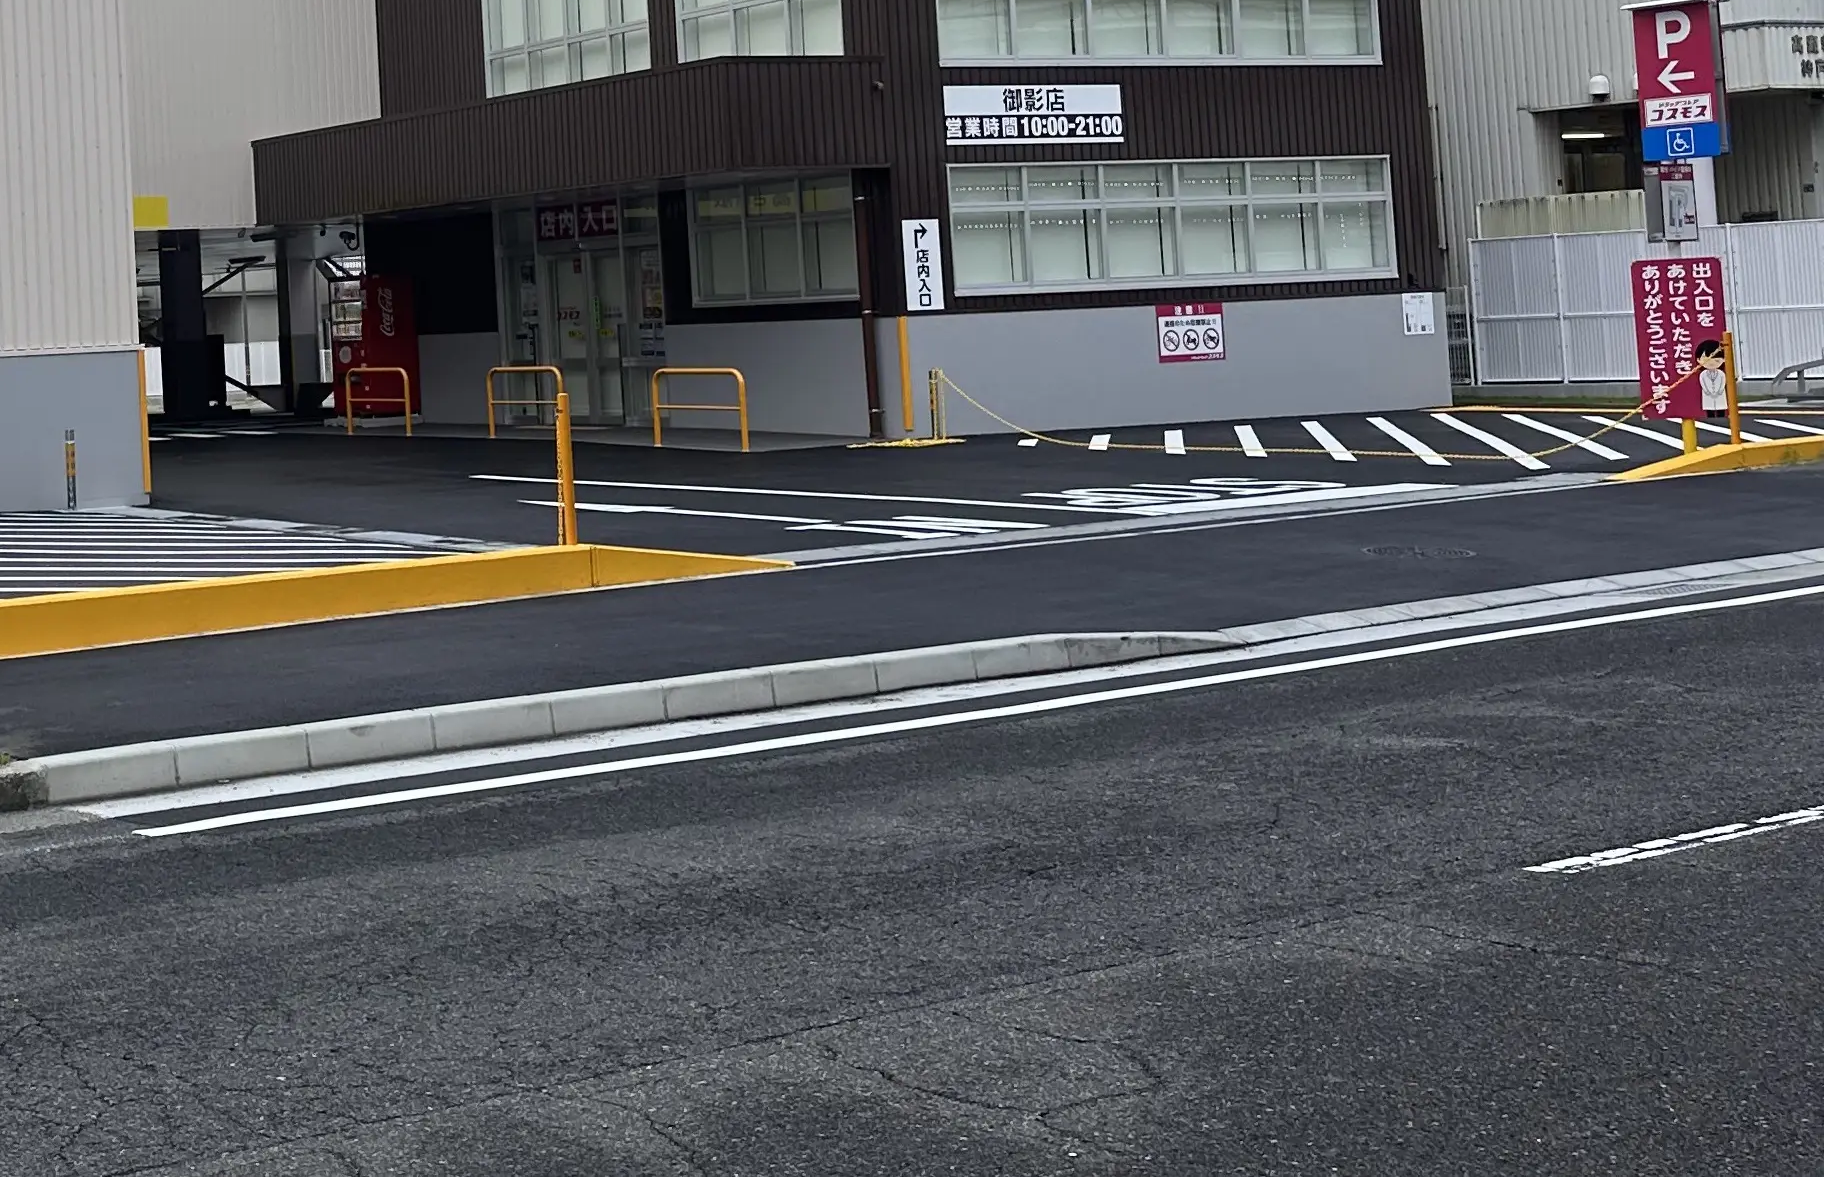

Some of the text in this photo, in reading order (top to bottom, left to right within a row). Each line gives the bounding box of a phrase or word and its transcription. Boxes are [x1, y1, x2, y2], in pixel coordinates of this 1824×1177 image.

[1655, 10, 1691, 59] P
[1002, 87, 1065, 113] 御影店
[1650, 105, 1707, 122] コスモス
[540, 205, 617, 238] 店内入口
[915, 249, 932, 307] 店内入口
[1692, 262, 1714, 327] 出入口を
[1641, 265, 1669, 415] ありがとうございます
[1666, 263, 1694, 376] あけていただき
